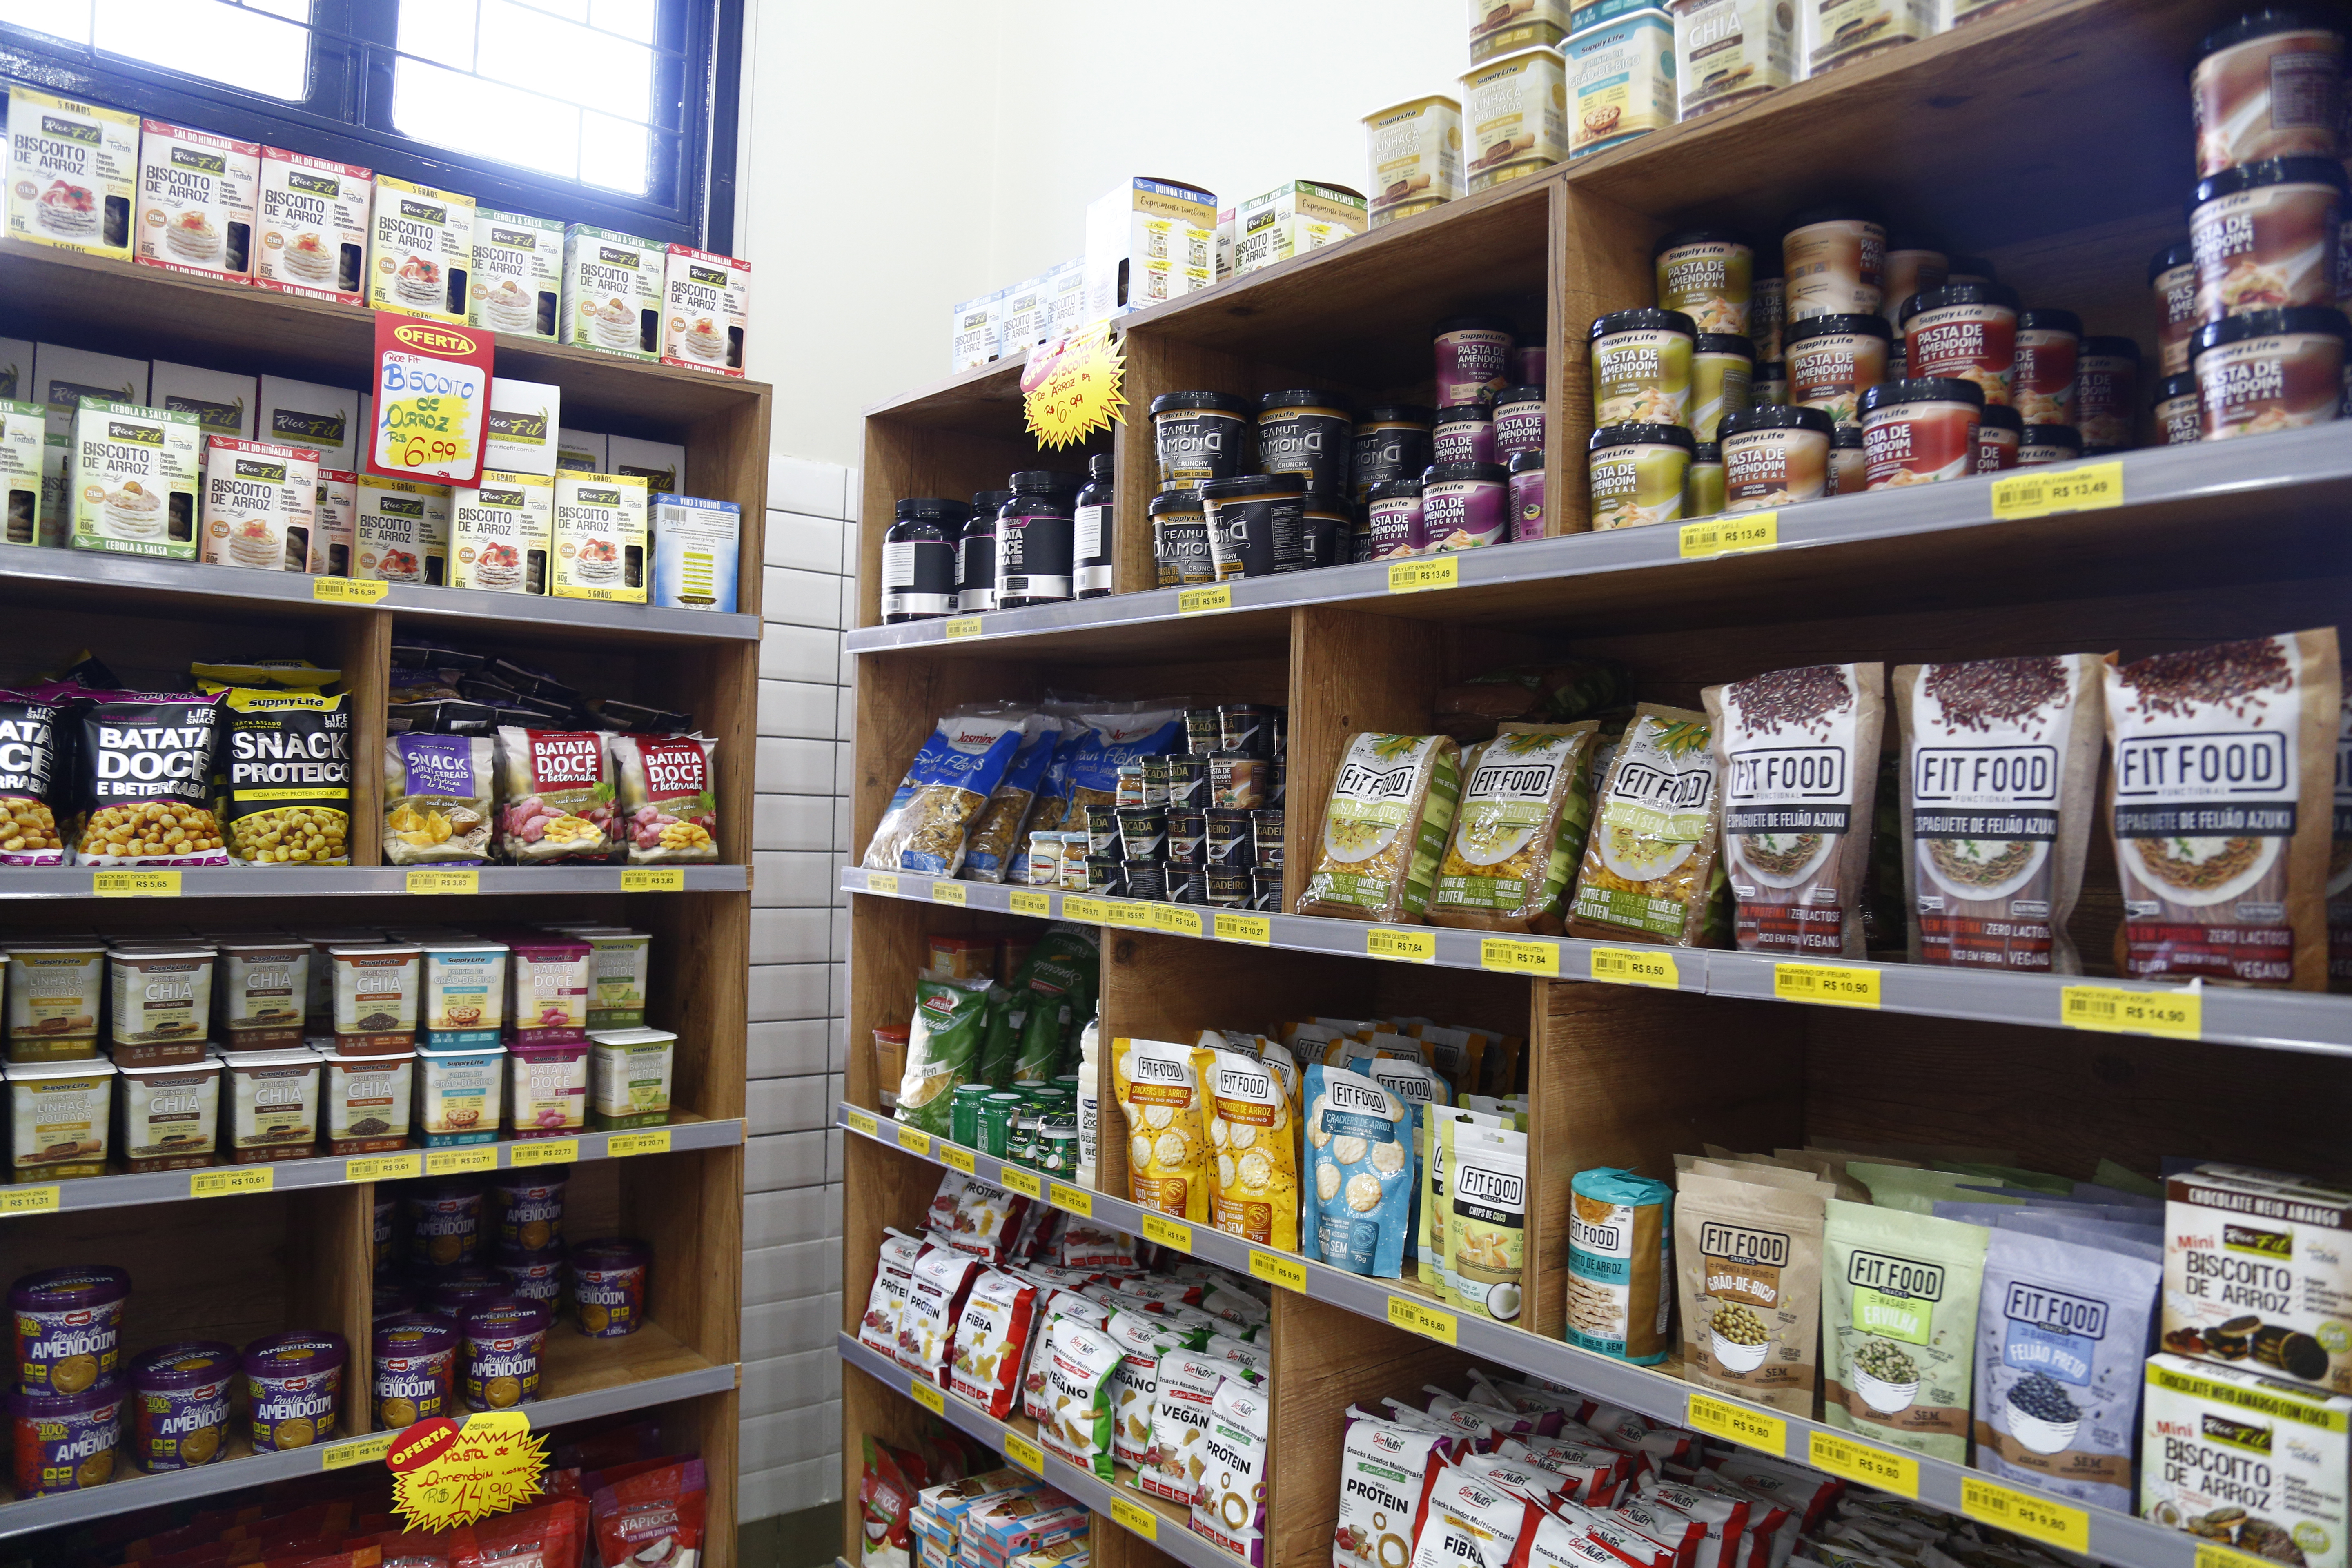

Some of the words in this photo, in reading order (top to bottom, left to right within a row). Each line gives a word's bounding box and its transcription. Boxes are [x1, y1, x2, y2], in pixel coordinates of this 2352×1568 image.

[174, 129, 186, 138] SAL
[187, 131, 196, 140] DO
[198, 132, 232, 150] HIMALAIA
[1376, 129, 1420, 152] LINHAÇA
[174, 152, 196, 163] Rice
[198, 156, 226, 172] Fit
[1376, 143, 1420, 164] DOURADA
[146, 165, 210, 191] BISCOITO
[145, 180, 162, 193] DE
[168, 185, 209, 203] ARROZ
[1155, 185, 1178, 198] QUINOA
[1179, 189, 1182, 198] E
[1184, 190, 1198, 202] CHIA
[1140, 196, 1180, 213] Experimente
[1181, 205, 1209, 220] também:
[1669, 248, 1700, 260] Supply
[1702, 245, 1724, 254] Life
[1668, 263, 1700, 278] PASTA
[1704, 260, 1725, 272] DE
[1669, 271, 1725, 287] AMENDOIM
[399, 327, 472, 354] OFERTA
[1051, 378, 1075, 398] ARROZ
[111, 404, 138, 417] CEBOLA
[140, 408, 147, 417] &
[149, 410, 172, 421] SALSA
[1056, 394, 1083, 423] 6,99
[83, 441, 150, 463] BISCOITO
[404, 436, 456, 466] 6,99
[83, 456, 99, 468] DE
[106, 459, 149, 476] ARROZ
[1726, 531, 1738, 541] R$
[1740, 528, 1766, 540] 13,49
[1432, 570, 1450, 579] 13,49
[1211, 596, 1225, 605] 19,90
[249, 698, 295, 708] Supply
[298, 697, 324, 707] Life
[100, 727, 211, 750] BATATA
[232, 732, 350, 759] SNACK
[957, 731, 997, 745] Jasmine
[535, 740, 596, 756] BATATA
[98, 751, 209, 782] DOCE
[408, 751, 465, 771] SNACK
[537, 755, 597, 775] DOCE
[233, 762, 350, 783] PROTEICO
[412, 766, 434, 776] MULTI
[435, 769, 469, 780] CEREAIS
[547, 768, 597, 782] beterraba
[1474, 770, 1500, 795] FIT
[1503, 768, 1548, 793] FOOD
[1922, 756, 1964, 791] FIT
[1975, 756, 2048, 791] FOOD
[97, 781, 108, 795] E
[113, 782, 206, 799] BETERRABA
[1915, 817, 1967, 833] ESPAGUETE
[1970, 817, 1984, 833] DE
[1986, 815, 2022, 833] FEIJÃO
[2026, 817, 2057, 835] AZUKI
[150, 880, 167, 889] 5,65
[1249, 927, 1264, 936] 10,27
[1398, 943, 1406, 951] R$
[1408, 943, 1422, 952] 7,84
[434, 974, 496, 984] GRÃO-DE-BICO
[533, 964, 574, 975] BATATA
[534, 975, 573, 988] DOCE
[1823, 980, 1836, 991] R$
[1840, 981, 1868, 993] 10,90
[145, 981, 194, 1002] CHIA
[534, 987, 555, 996] ROXA
[1142, 1060, 1154, 1077] FIT
[1155, 1061, 1180, 1079] FOOD
[1132, 1085, 1156, 1096] CRACKERS
[1158, 1088, 1166, 1097] DE
[1167, 1087, 1188, 1099] ARROZ
[244, 1176, 265, 1185] 10,61
[1075, 1199, 1087, 1208] 25,90
[2189, 1189, 2252, 1214] CHOCOLATE
[2257, 1198, 2284, 1217] MEIO
[2288, 1203, 2340, 1226] AMARGO
[1469, 1205, 1485, 1218] CHIPS
[1486, 1209, 1492, 1219] DE
[1492, 1211, 1507, 1223] COCO
[1176, 1234, 1187, 1243] 8,99
[1707, 1228, 1733, 1254] FIT
[1737, 1234, 1783, 1263] FOOD
[1716, 1263, 1741, 1276] PIMENTA
[1744, 1267, 1751, 1276] DO
[1753, 1270, 1770, 1278] REINO
[2187, 1252, 2291, 1292] BISCOITO
[1708, 1272, 1776, 1303] GRÃO-DE-BICO
[2187, 1277, 2210, 1298] DE
[2222, 1285, 2290, 1315] ARROZ
[68, 1315, 89, 1323] select
[966, 1314, 992, 1332] FIBRA
[1420, 1317, 1429, 1326] R$
[1431, 1321, 1445, 1332] 6,80
[1864, 1307, 1918, 1335] ERVILHA
[52, 1329, 85, 1342] Pasta
[87, 1325, 101, 1337] de
[32, 1329, 116, 1359] AMENDOIM
[2011, 1343, 2048, 1365] FEIJÃO
[2052, 1350, 2086, 1376] PRETO
[1734, 1420, 1746, 1430] R$
[1748, 1423, 1768, 1439] 9,80
[392, 1426, 452, 1465] OFERTA
[1347, 1446, 1366, 1459] Snacks
[1367, 1453, 1389, 1467] Assados
[1389, 1462, 1423, 1479] Multicereais
[1348, 1479, 1408, 1514] PROTEIN
[621, 1513, 679, 1530] TAPIOCA
